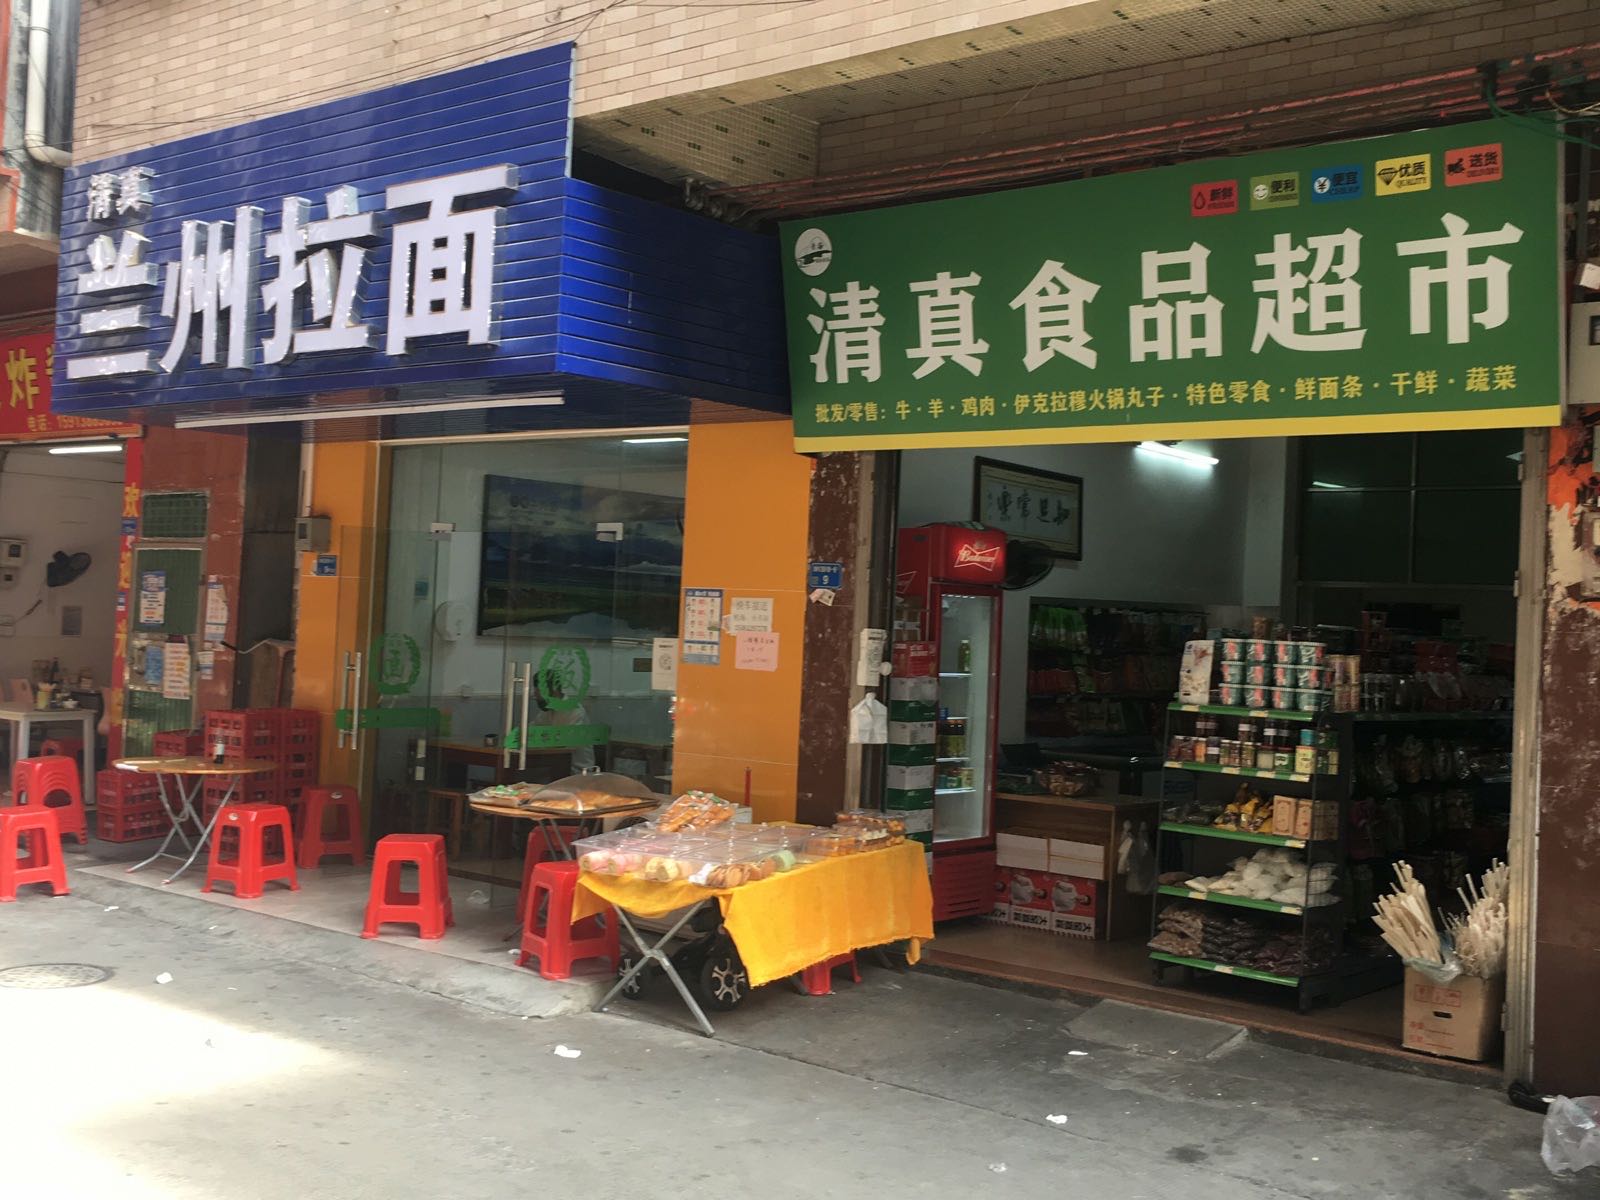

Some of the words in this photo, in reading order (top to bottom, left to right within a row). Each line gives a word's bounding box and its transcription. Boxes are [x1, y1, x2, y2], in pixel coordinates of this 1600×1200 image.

[1271, 179, 1296, 193] 便利
[1399, 161, 1426, 178] 优质
[67, 163, 518, 380] 兰州拉面
[807, 212, 1524, 384] 清真食品超市
